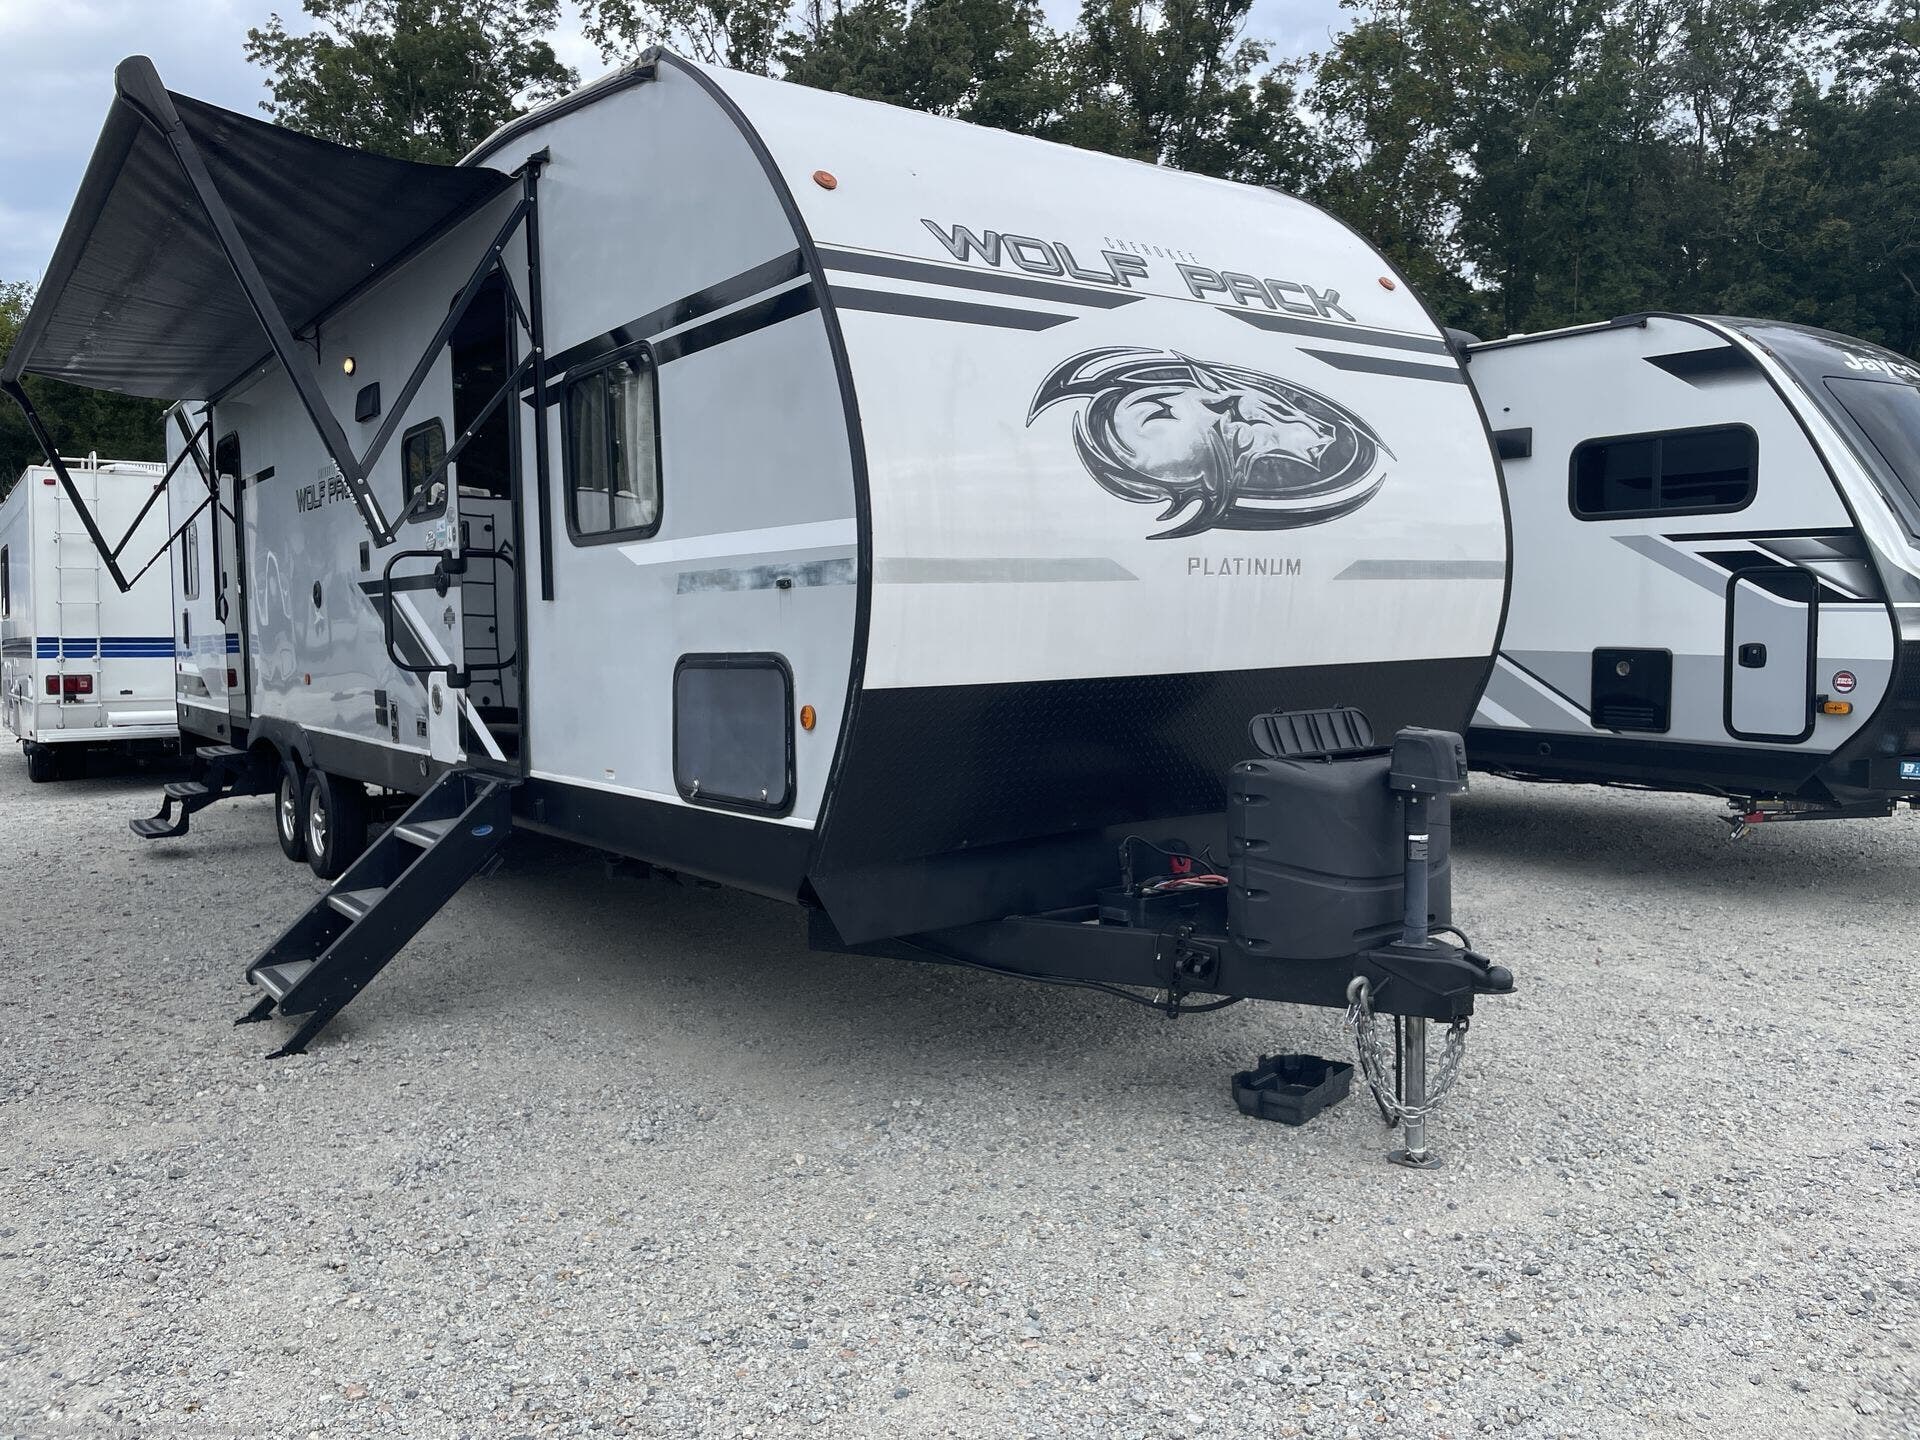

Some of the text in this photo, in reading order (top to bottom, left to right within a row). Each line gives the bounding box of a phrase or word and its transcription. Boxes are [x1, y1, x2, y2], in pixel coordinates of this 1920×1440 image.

[1104, 236, 1200, 264] CHEROKEE
[920, 218, 1356, 322] WOLF PACK
[1842, 351, 1920, 379] Jayco
[295, 474, 351, 513] WOLF PA
[1187, 557, 1301, 576] PLATINUM
